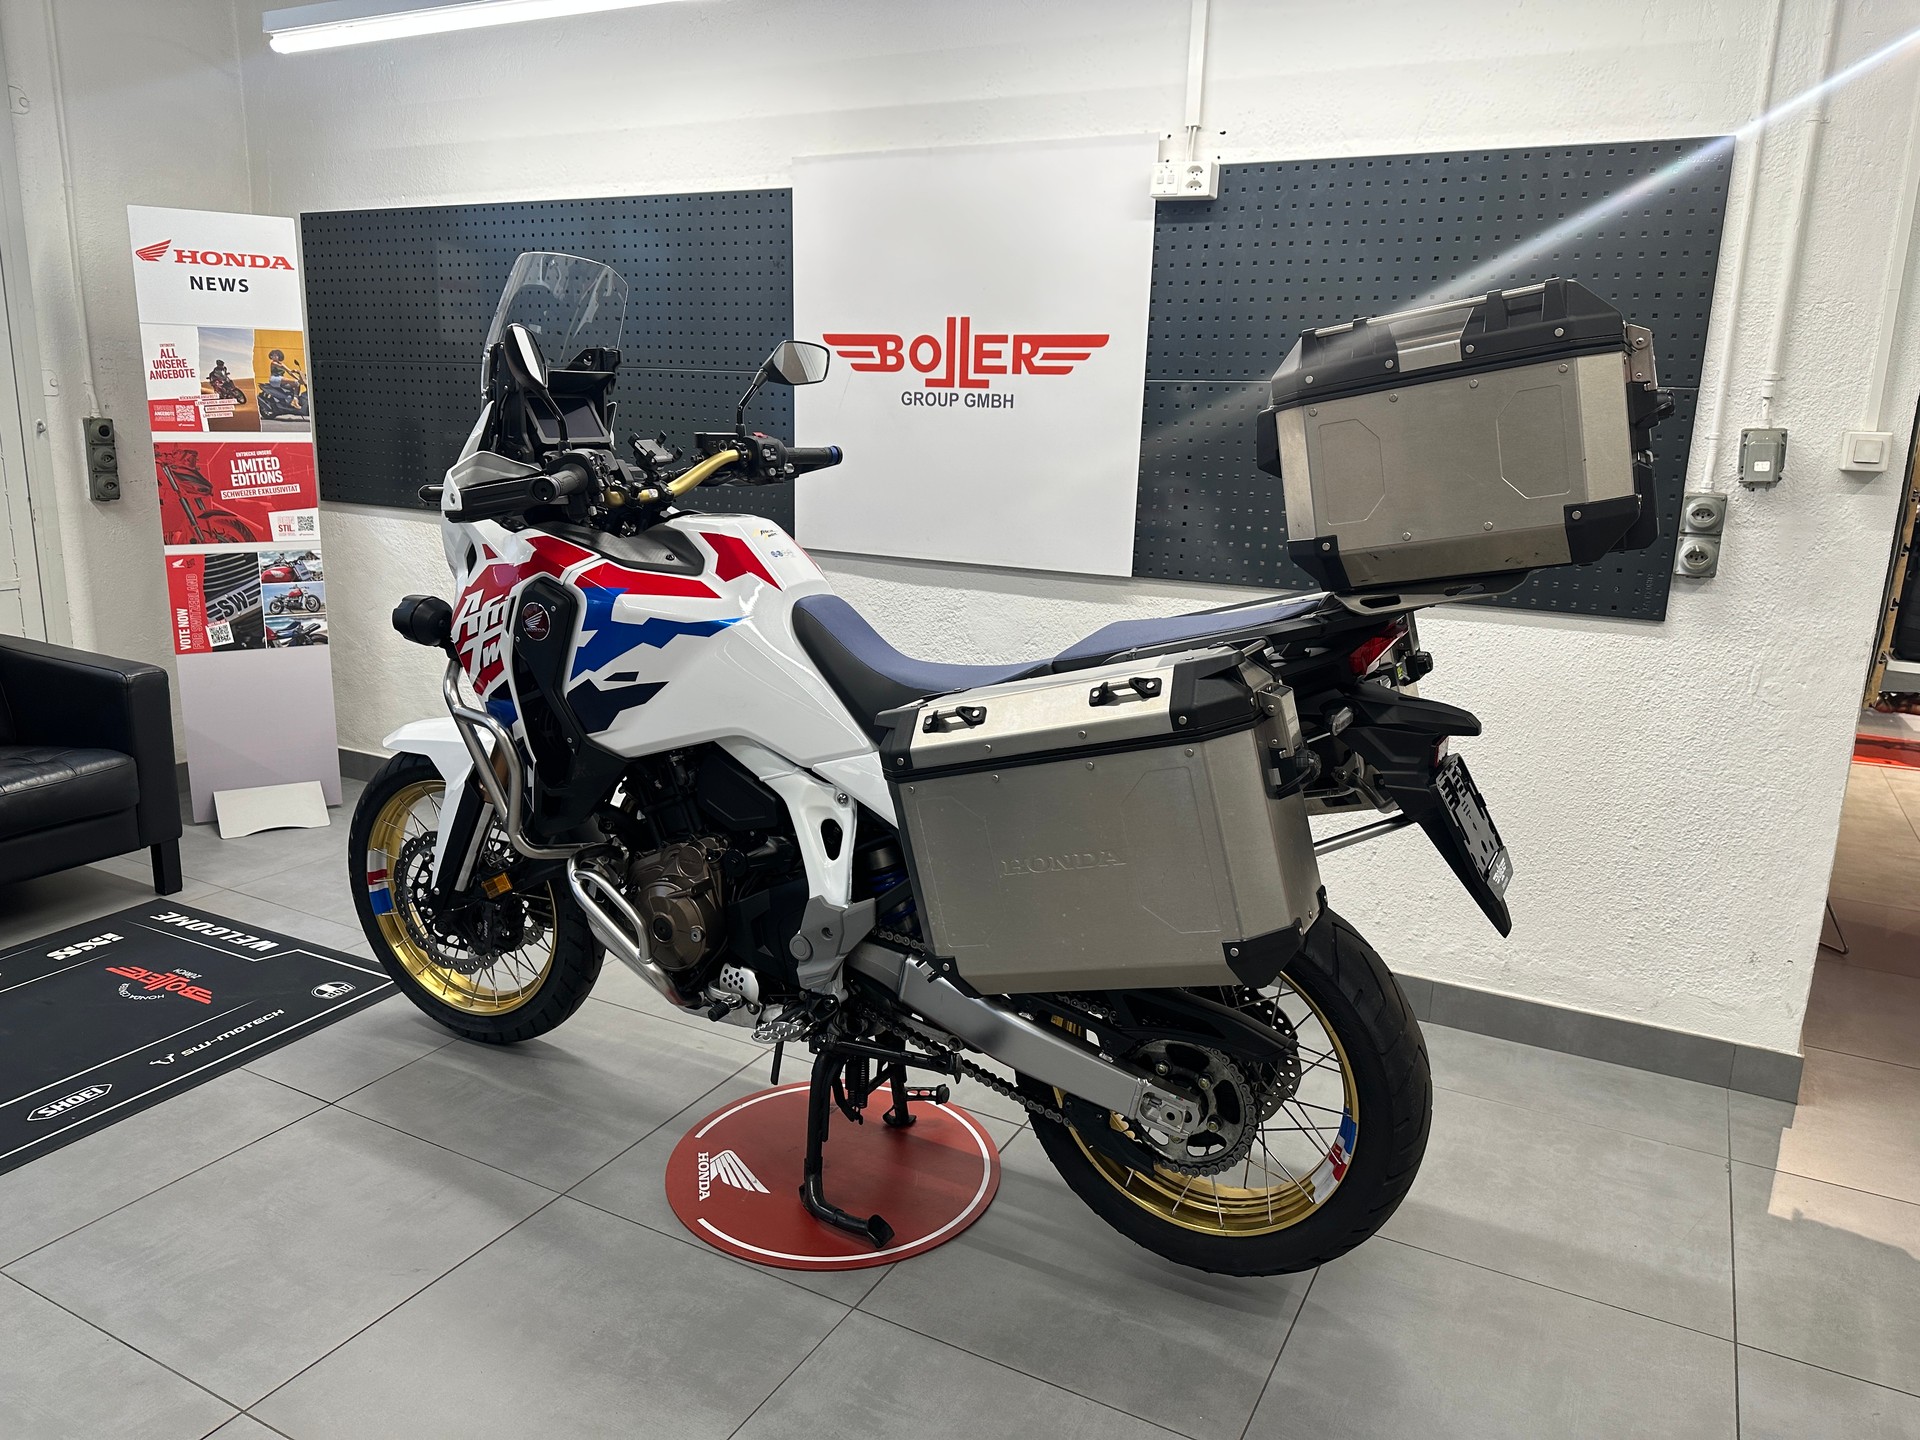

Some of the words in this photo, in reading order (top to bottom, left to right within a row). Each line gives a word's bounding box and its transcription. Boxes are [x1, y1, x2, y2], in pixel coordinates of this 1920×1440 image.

[173, 249, 295, 270] HONDA
[189, 275, 249, 293] NEWS
[160, 348, 178, 359] ALL
[822, 316, 1110, 389] BOLLER
[152, 358, 188, 369] UNSERE
[149, 368, 196, 380] ANGEBOTE
[900, 391, 959, 408] GROUP
[964, 393, 1014, 409] GMBH
[230, 456, 280, 474] LIMITED
[230, 470, 284, 487] EDITIONS
[222, 488, 257, 498] SCHWEIZER
[186, 573, 203, 632] SWITZERLAND
[217, 590, 249, 618] SW
[176, 608, 189, 628] NOW
[178, 628, 192, 651] VOTE
[191, 632, 205, 650] FOR
[1000, 851, 1127, 876] HONDA
[149, 911, 280, 952] WELCOME
[104, 966, 213, 1005] BOLLER
[128, 993, 165, 1001] HONDA
[181, 1008, 285, 1057] SW-MOTECH
[37, 1086, 105, 1118] SHOEI
[697, 1152, 711, 1201] HONDA
